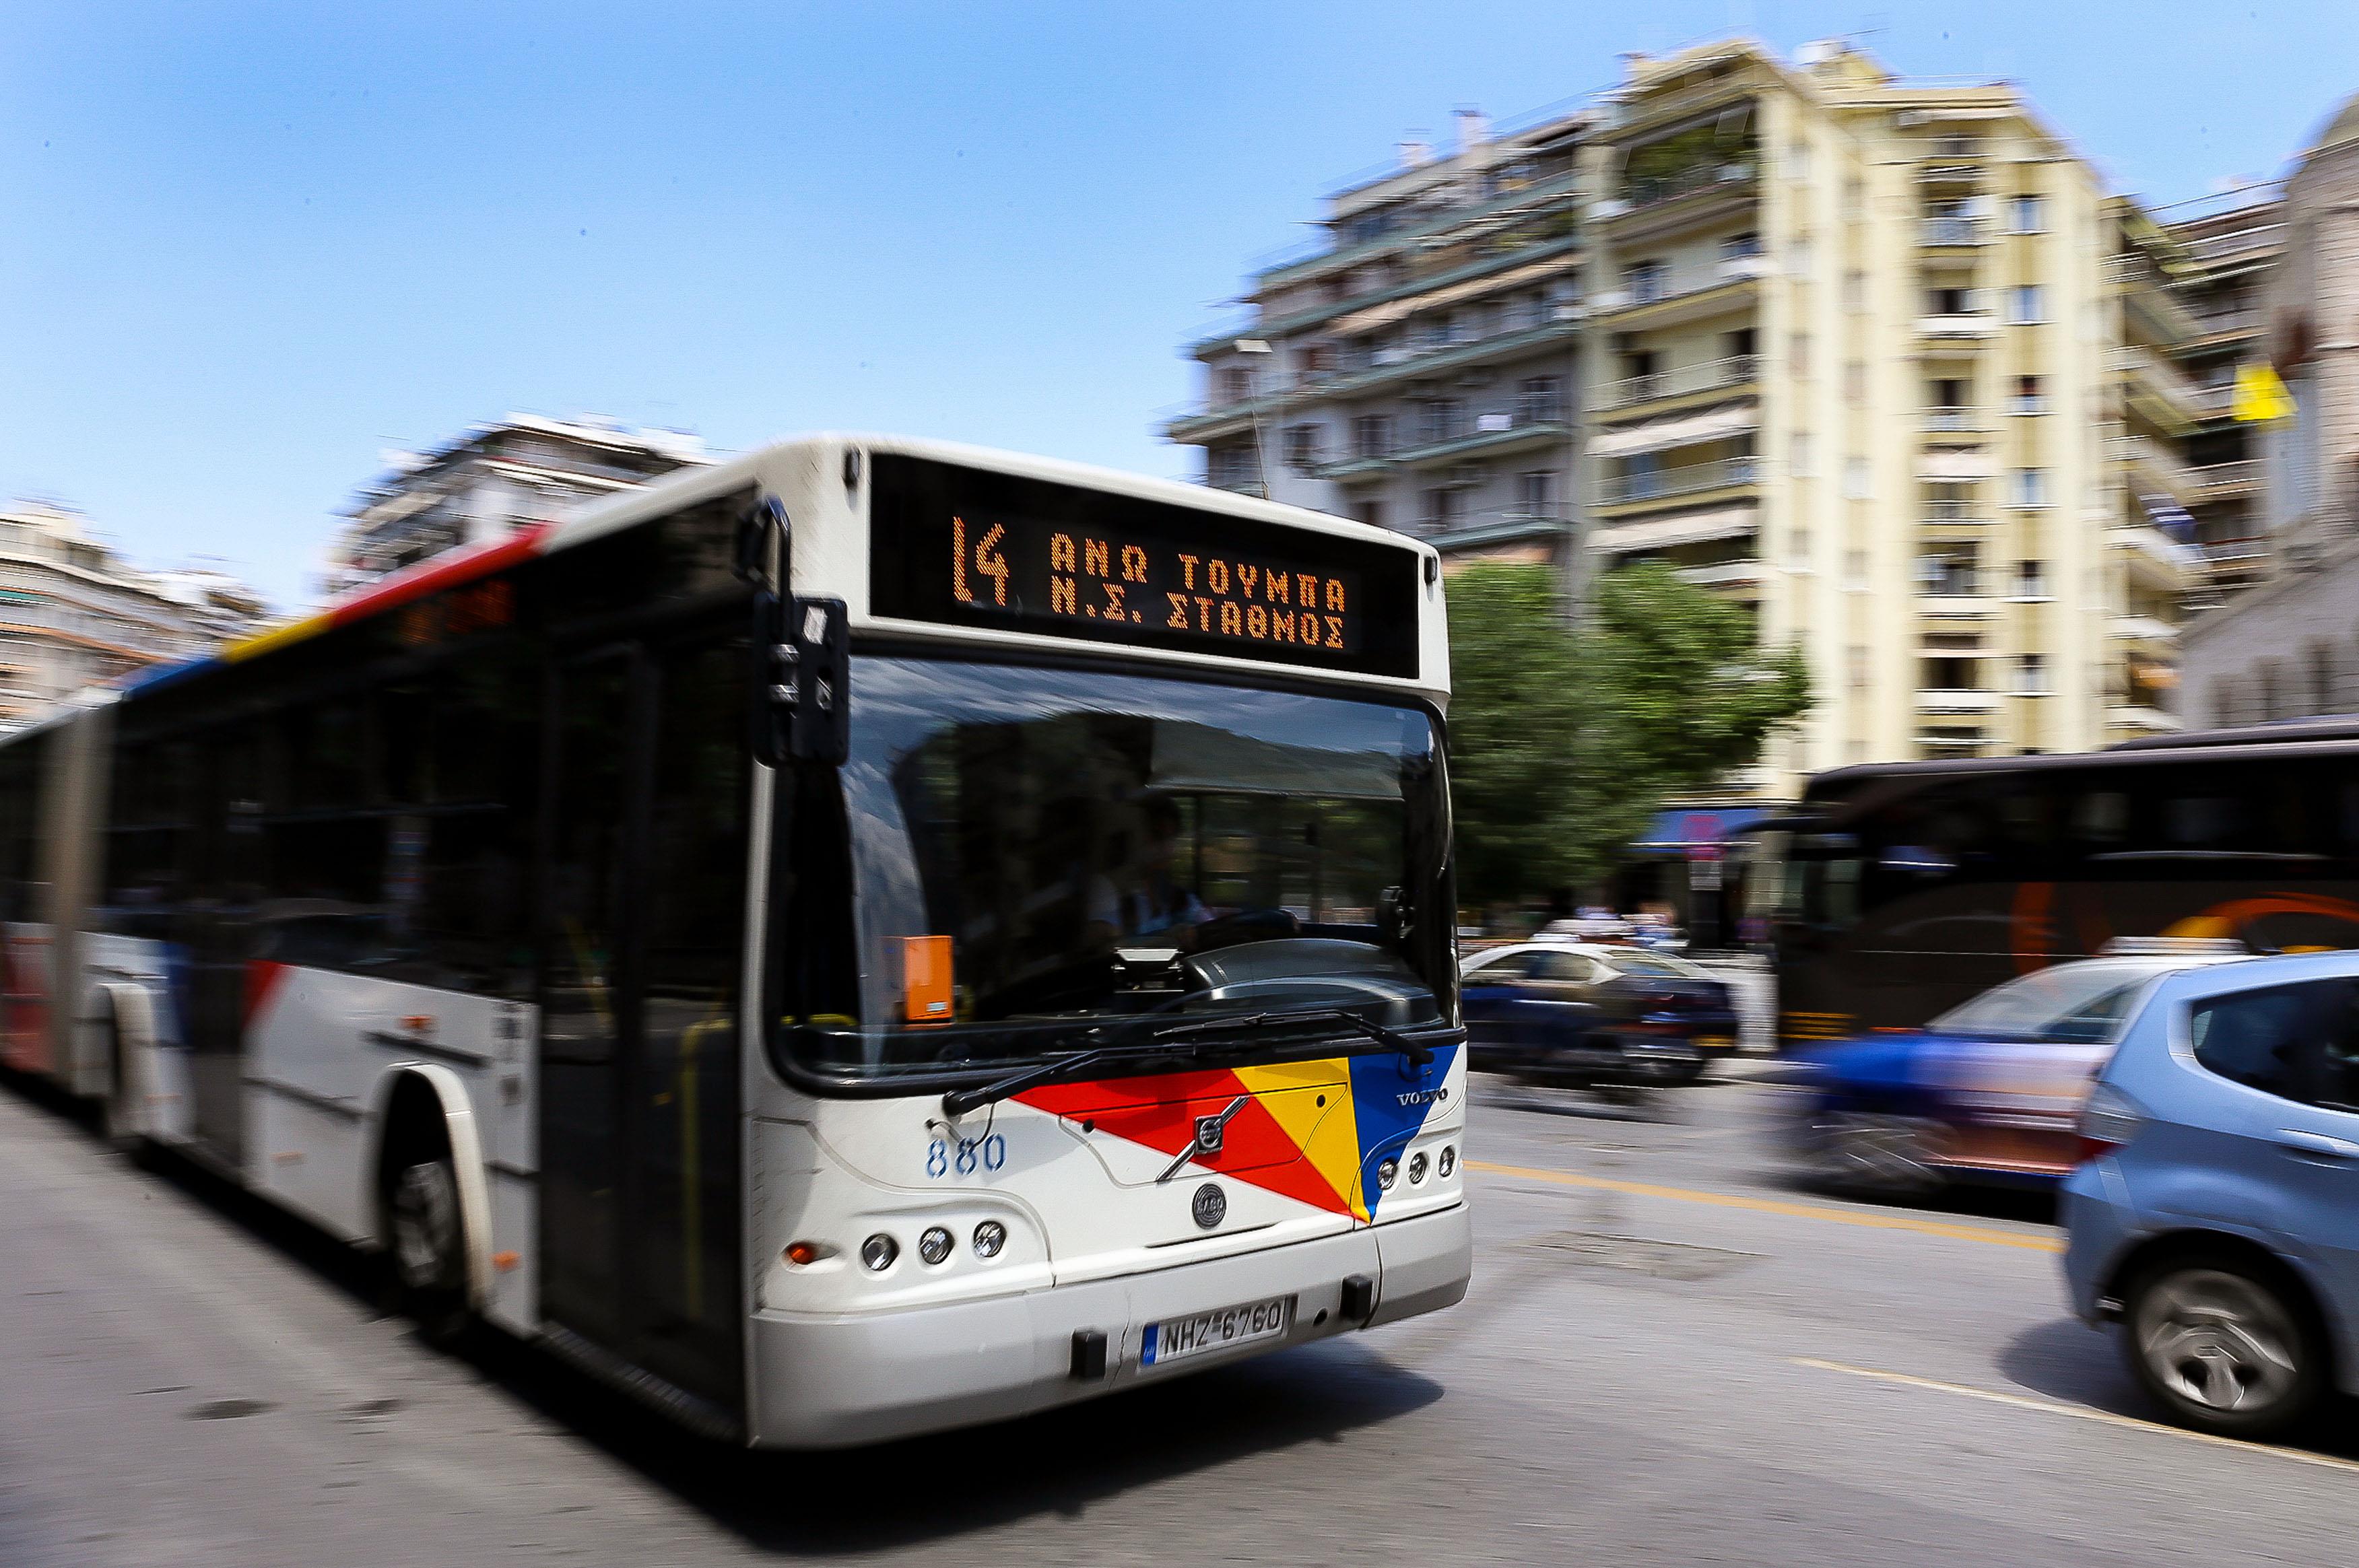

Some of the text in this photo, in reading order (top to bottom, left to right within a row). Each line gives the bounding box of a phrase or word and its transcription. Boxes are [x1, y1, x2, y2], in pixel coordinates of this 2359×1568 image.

[953, 516, 1009, 607] 14
[1051, 533, 1345, 613] ΑΝΩ ΤΟΥΜΠΑ
[1167, 592, 1343, 649] ΣΤΑΘΜΟΣ
[1396, 1088, 1449, 1106] VOLVO
[925, 1133, 1007, 1180] 880
